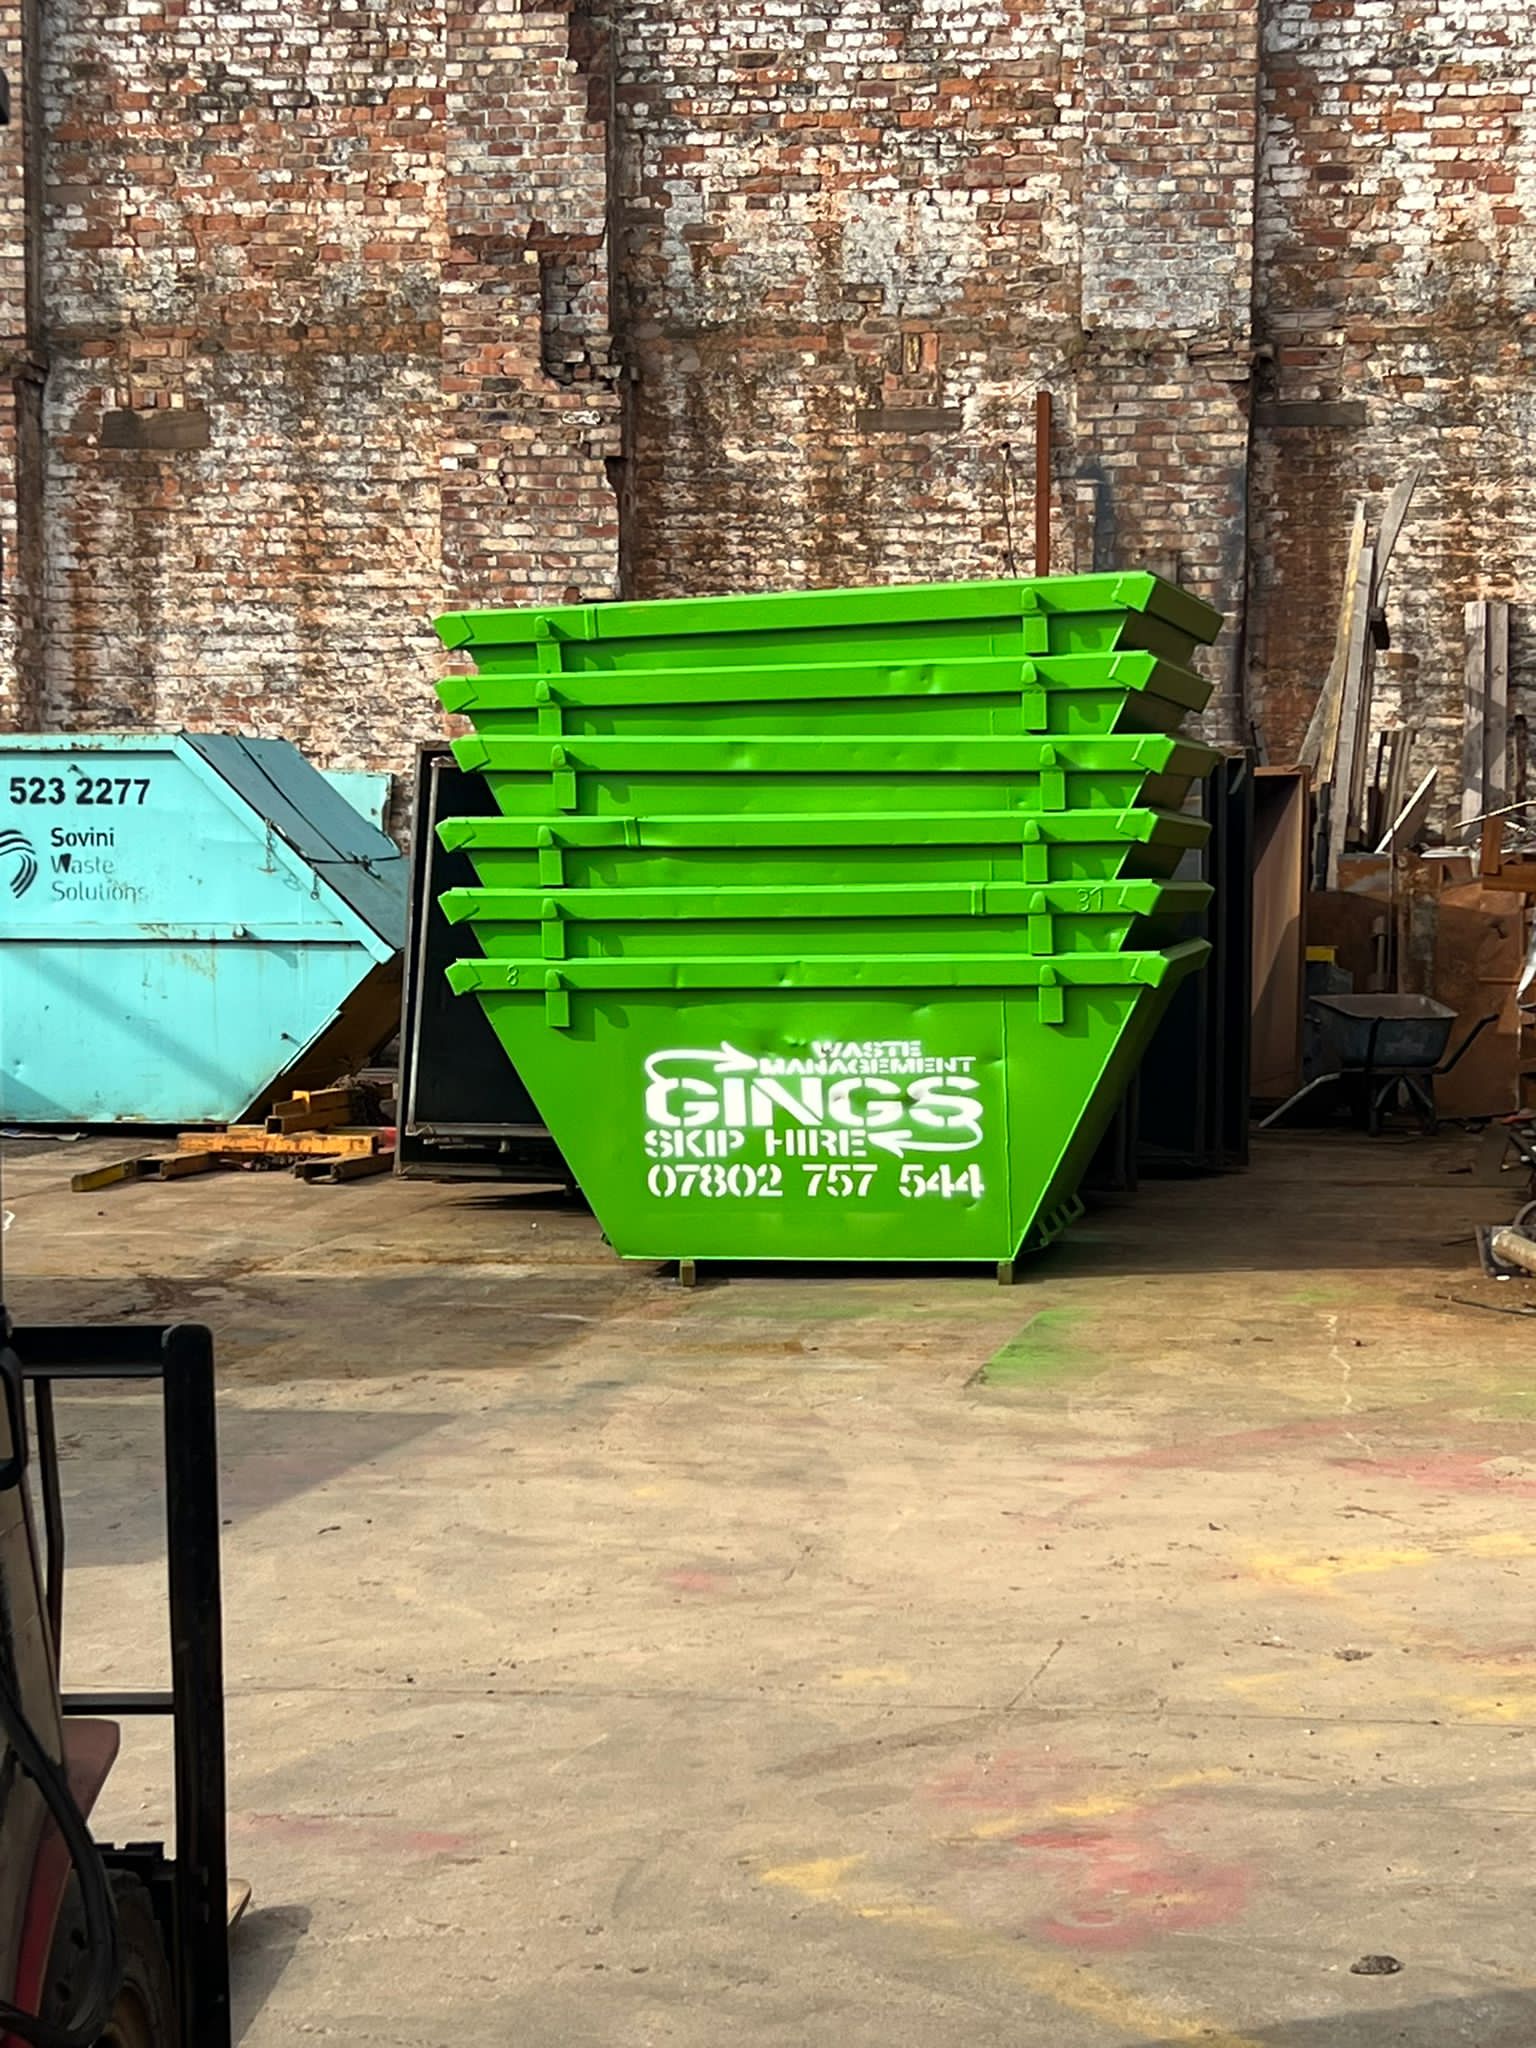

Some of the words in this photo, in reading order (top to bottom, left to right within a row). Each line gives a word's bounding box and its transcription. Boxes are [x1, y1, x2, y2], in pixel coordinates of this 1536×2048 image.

[10, 777, 66, 805] 523
[75, 777, 151, 805] 2277
[51, 827, 115, 847] Sovini
[51, 853, 115, 875] Waste
[811, 1040, 921, 1058] WASTE
[759, 1057, 976, 1075] MANAGEMENT
[645, 1076, 983, 1127] GINGS
[645, 1129, 745, 1157] SKIP
[765, 1129, 867, 1157] HIRE
[647, 1163, 783, 1197] 07802
[802, 1163, 878, 1197] 757
[899, 1163, 984, 1197] 544
